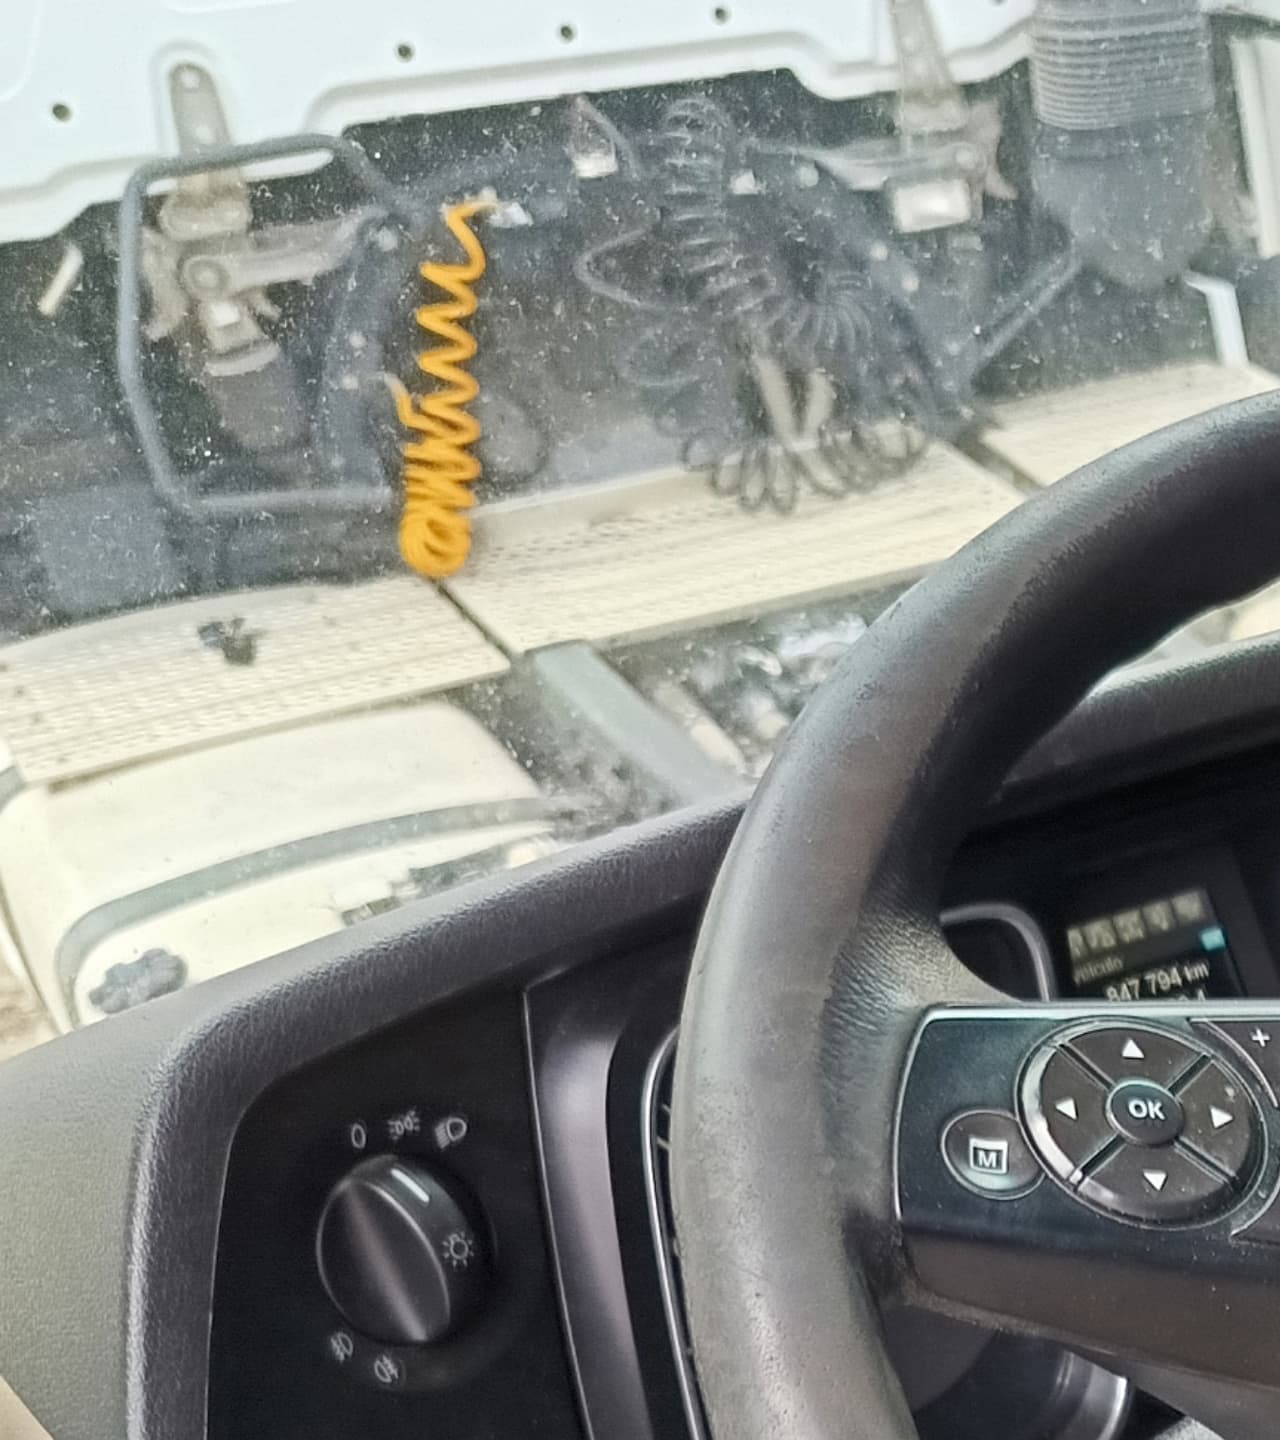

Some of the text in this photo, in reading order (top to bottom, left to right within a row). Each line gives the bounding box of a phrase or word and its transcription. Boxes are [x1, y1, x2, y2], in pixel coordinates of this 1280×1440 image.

[1144, 966, 1182, 995] 794
[1184, 961, 1210, 983] km
[1128, 1101, 1166, 1121] OK
[977, 1151, 998, 1169] M
